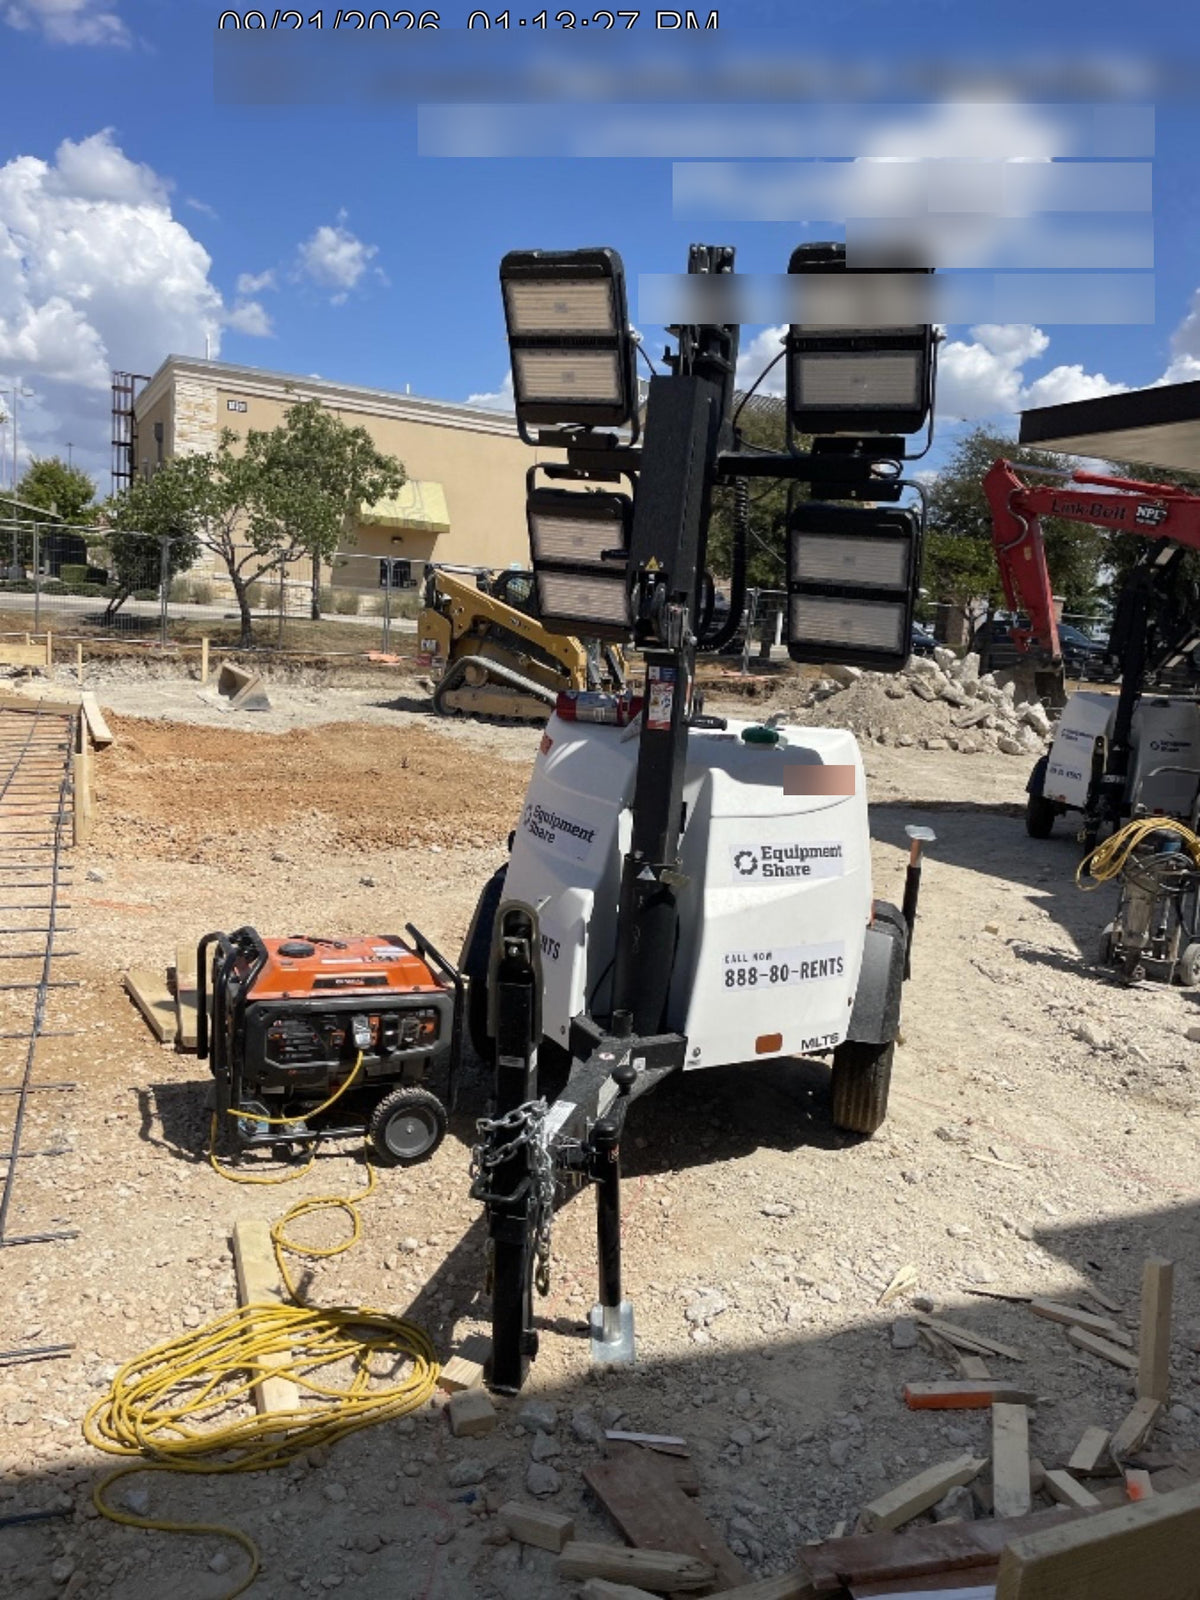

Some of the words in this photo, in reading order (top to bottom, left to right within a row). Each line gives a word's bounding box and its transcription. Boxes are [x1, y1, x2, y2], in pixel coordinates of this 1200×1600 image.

[528, 819, 556, 844] Share
[533, 804, 597, 844] Equipment
[760, 844, 842, 862] Equipment
[761, 863, 812, 878] Share
[724, 953, 748, 964] CALL
[724, 955, 844, 988] 888-80-RENTS
